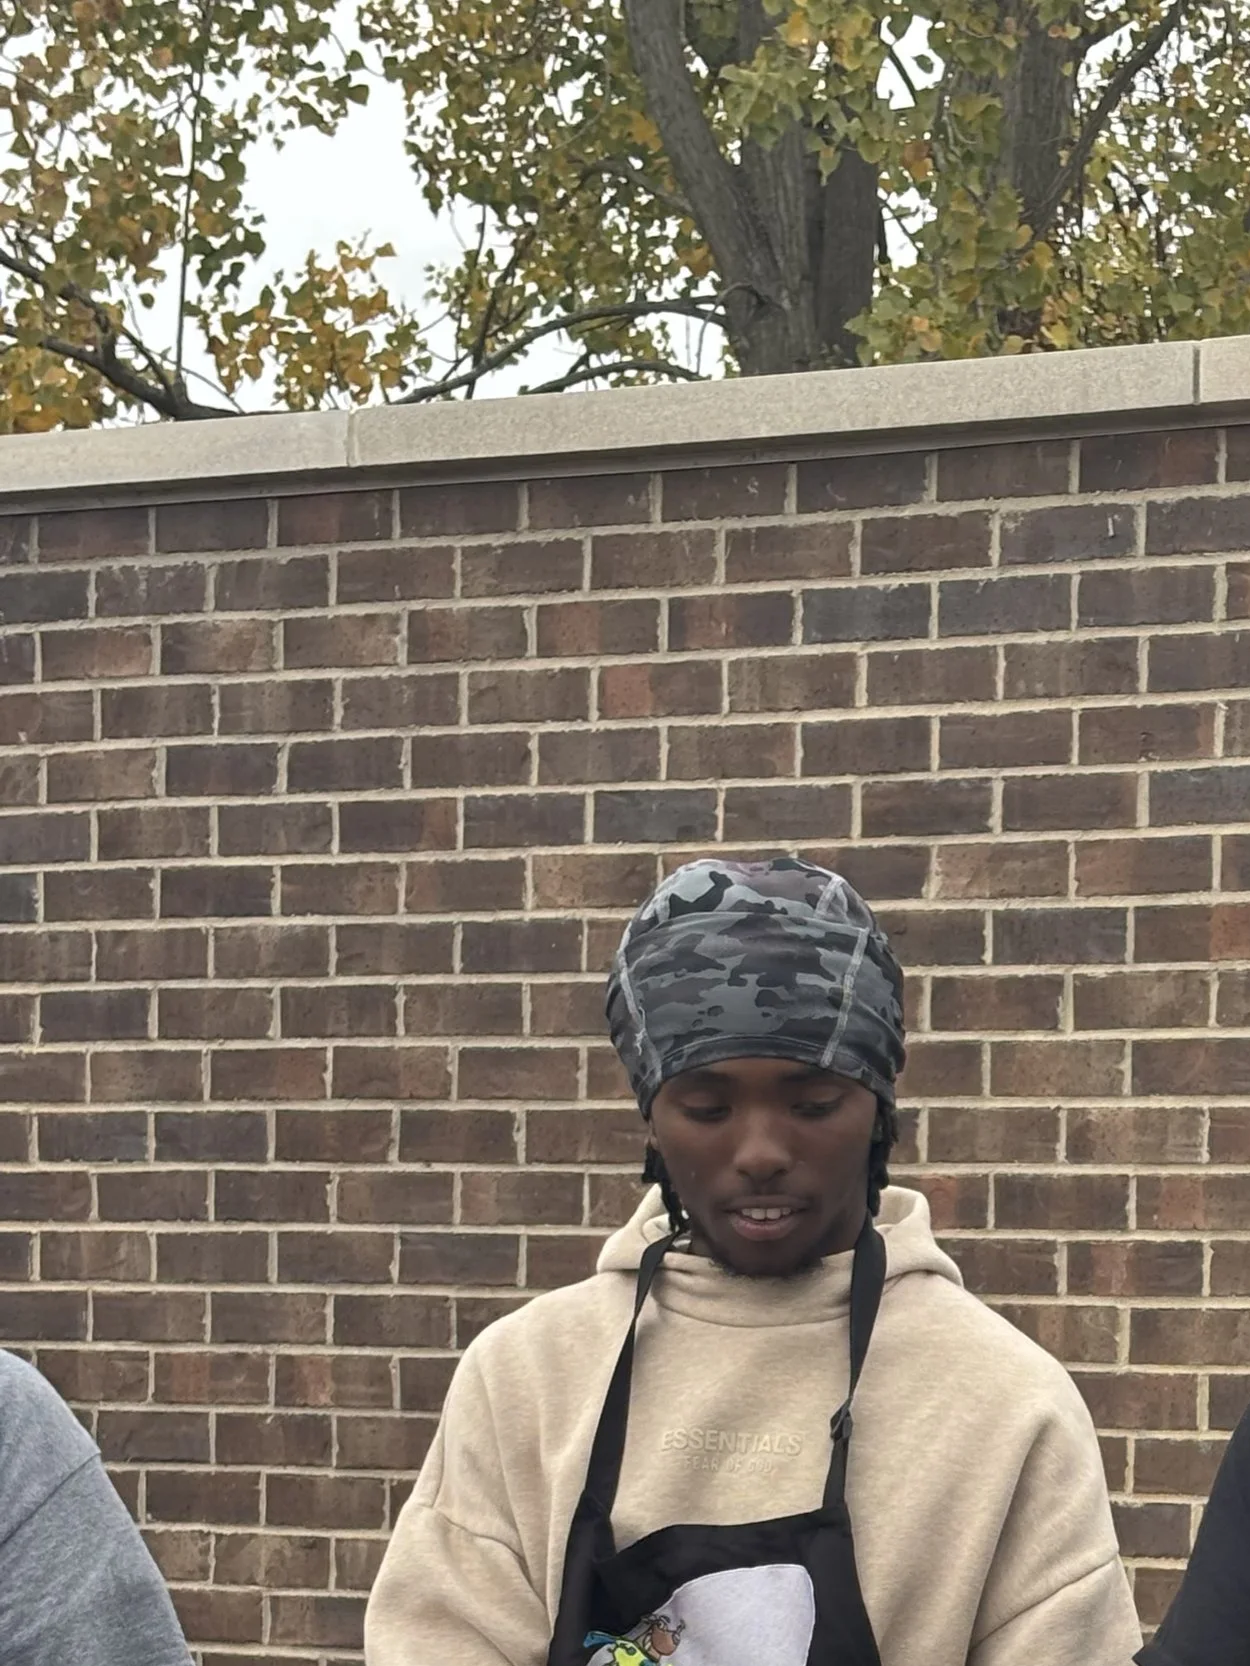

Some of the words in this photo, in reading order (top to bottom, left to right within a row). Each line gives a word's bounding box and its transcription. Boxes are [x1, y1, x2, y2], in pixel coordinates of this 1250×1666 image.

[661, 1427, 803, 1456] ESSENTIALS
[683, 1455, 720, 1472] FEAR
[726, 1458, 742, 1473] OF
[749, 1458, 773, 1473] GOD
